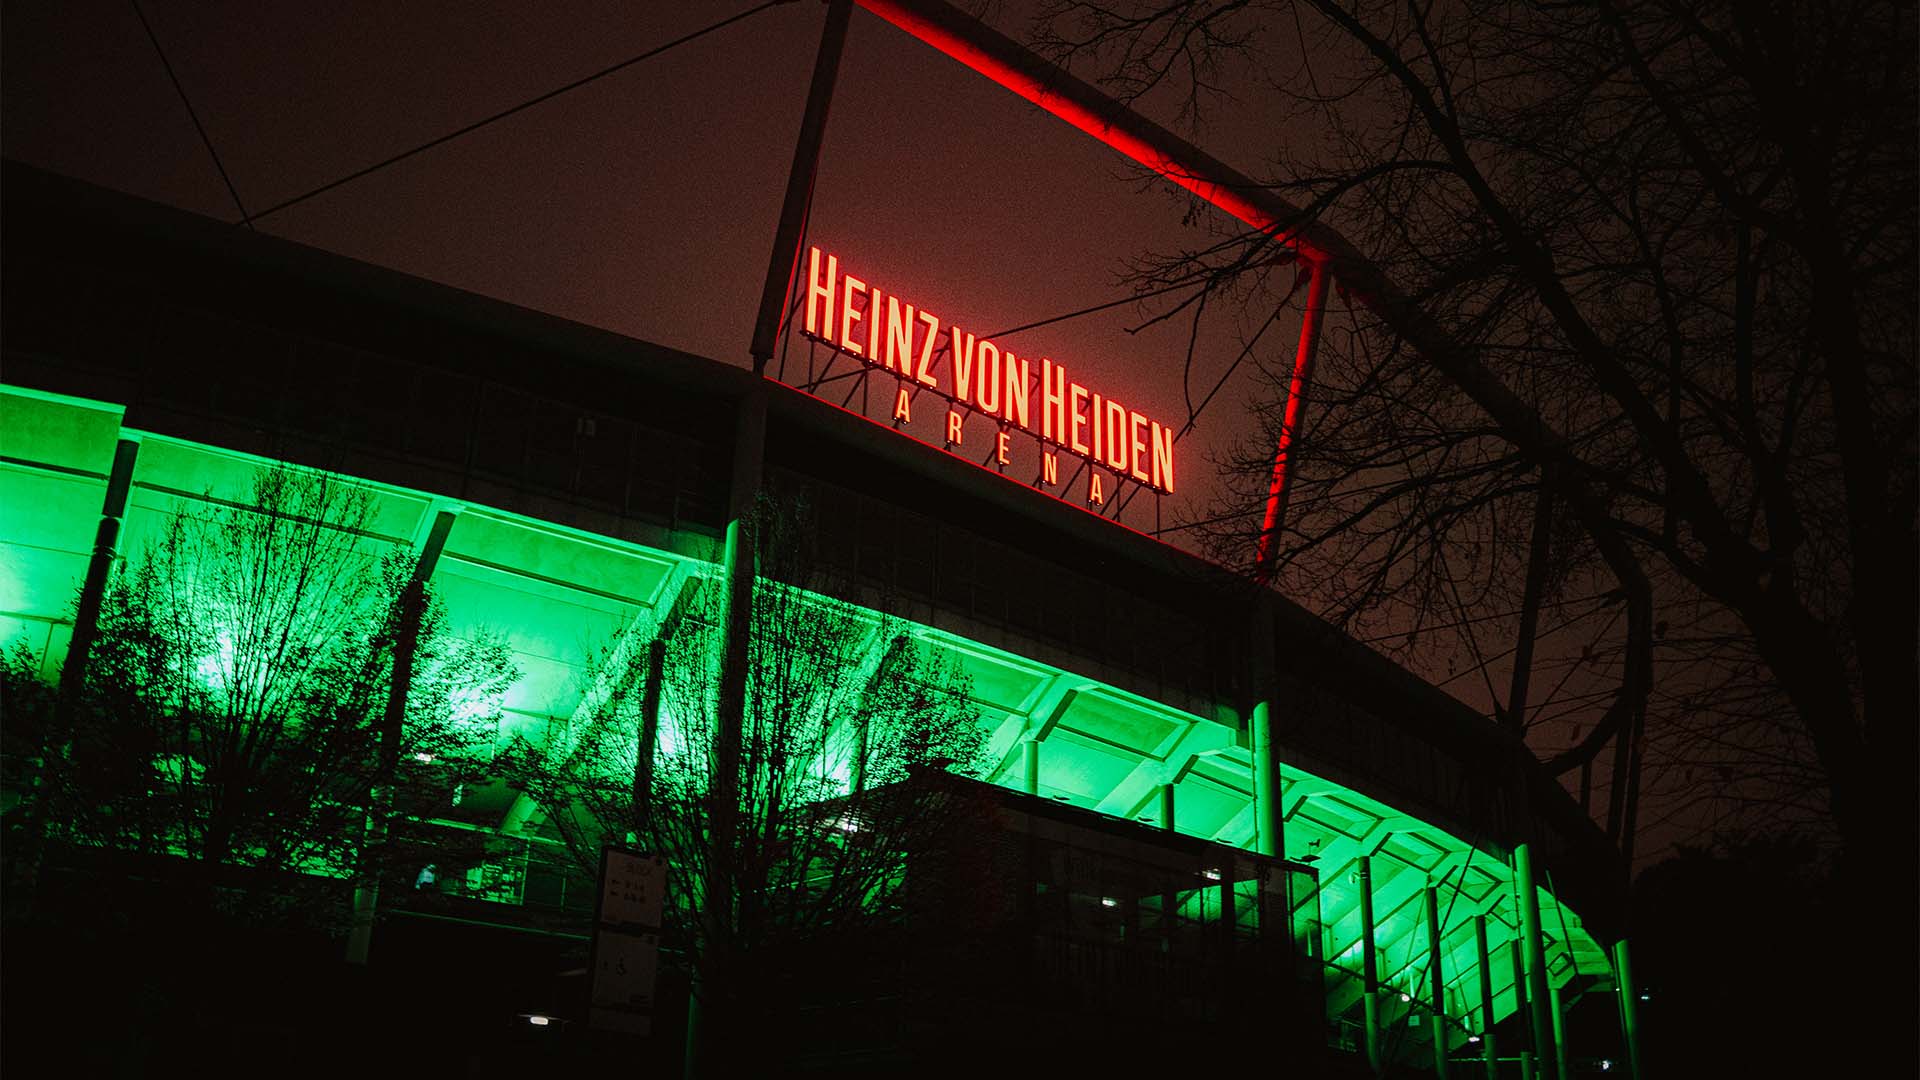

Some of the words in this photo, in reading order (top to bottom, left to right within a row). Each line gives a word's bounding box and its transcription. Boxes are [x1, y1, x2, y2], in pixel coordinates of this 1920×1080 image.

[805, 246, 940, 388] HEINZ
[951, 325, 1030, 429] VON
[1042, 357, 1175, 494] HEIDEN
[893, 388, 1105, 507] ARENA
